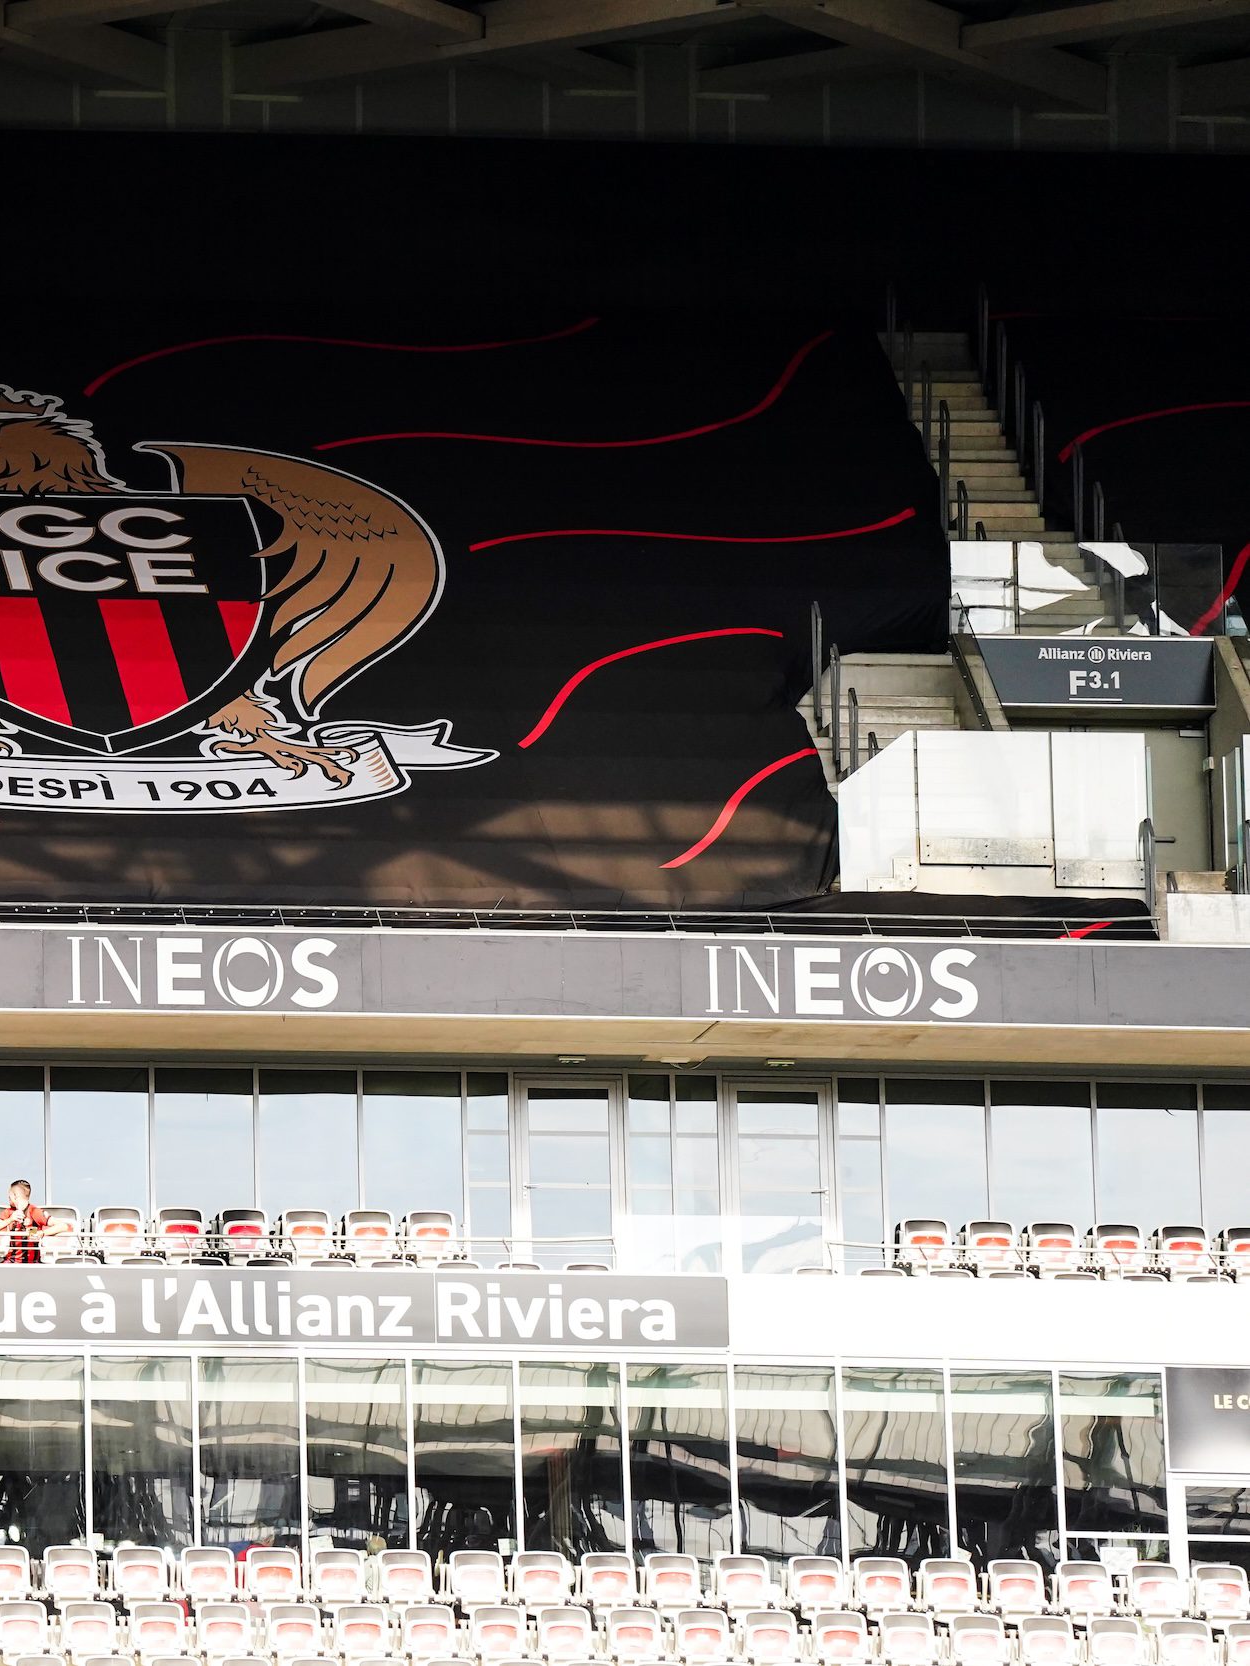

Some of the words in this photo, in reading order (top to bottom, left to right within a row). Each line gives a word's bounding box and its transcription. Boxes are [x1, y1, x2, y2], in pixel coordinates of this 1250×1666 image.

[1038, 647, 1085, 660] Allianz
[1107, 648, 1151, 661] Riviera
[137, 778, 278, 801] 1904
[66, 936, 339, 1008] INEOS
[703, 945, 979, 1019] INEOS
[80, 1276, 117, 1335] à
[141, 1278, 413, 1338] l'Allianz
[438, 1283, 677, 1341] Riviera
[1213, 1394, 1233, 1410] LE
